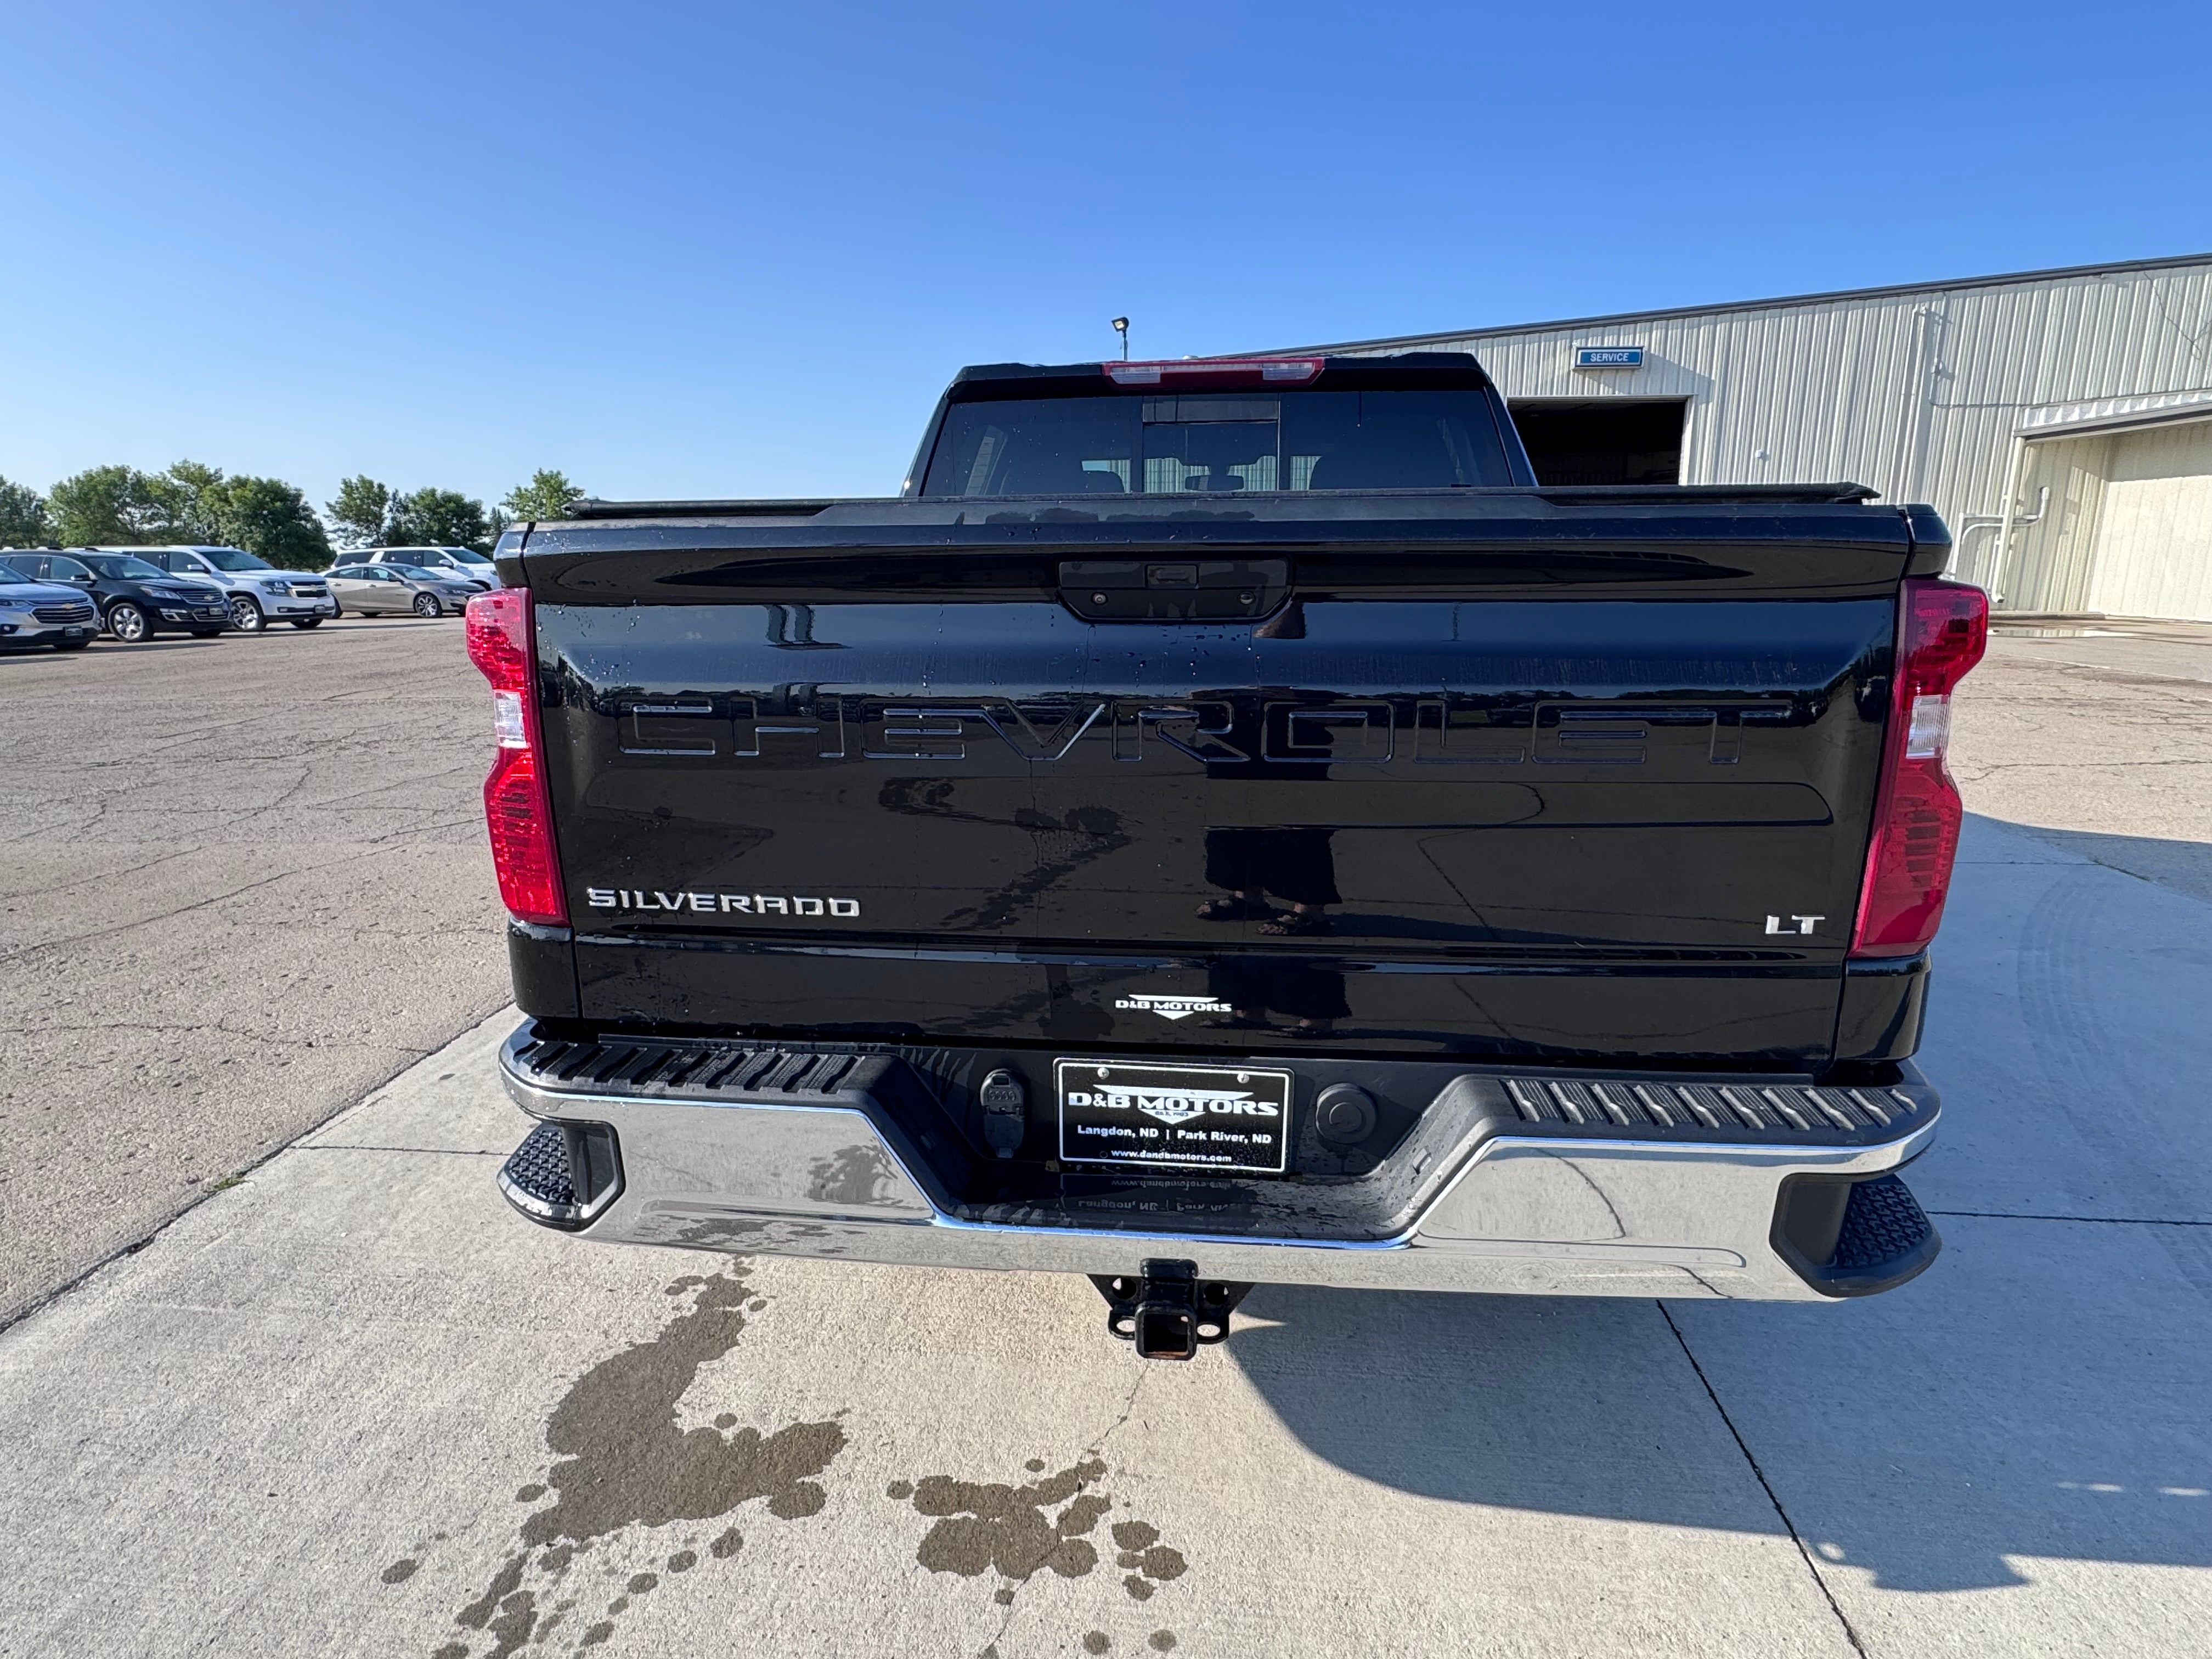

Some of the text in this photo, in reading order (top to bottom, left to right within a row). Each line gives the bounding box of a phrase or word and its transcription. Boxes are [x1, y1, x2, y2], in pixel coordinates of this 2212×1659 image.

[1590, 352, 1629, 362] SERVICE
[614, 695, 1794, 764] CHEVROLET
[587, 887, 860, 917] SILVERADO
[1764, 915, 1826, 935] LT
[1115, 1000, 1232, 1012] D&B MOTORS
[1068, 1092, 1279, 1116] D&B MOTORS
[1077, 1125, 1272, 1144] Langdon, ND Park River, ND
[1110, 1149, 1232, 1163] www.dandbmotors.com
